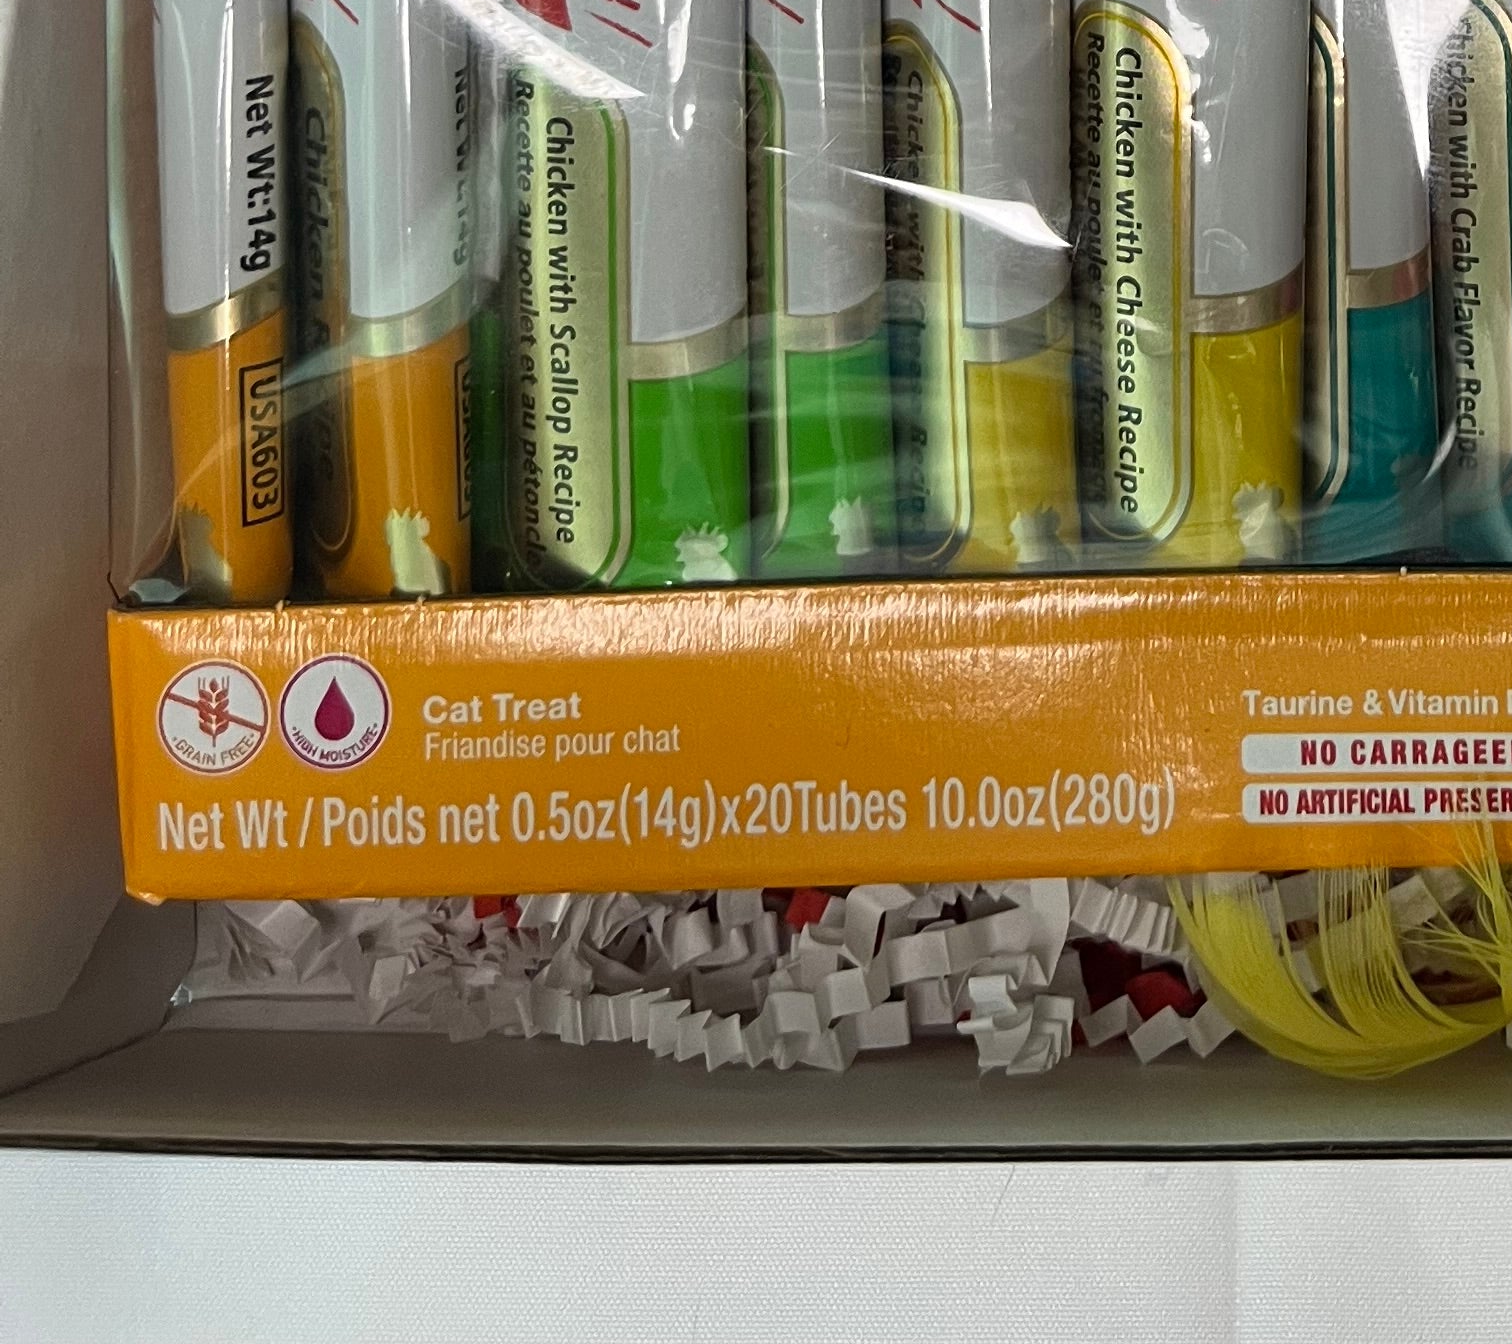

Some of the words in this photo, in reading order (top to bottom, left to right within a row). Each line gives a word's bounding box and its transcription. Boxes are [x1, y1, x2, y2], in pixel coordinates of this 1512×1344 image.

[244, 74, 275, 139] Net
[1085, 31, 1105, 145] Recette
[1115, 46, 1144, 179] Chicken
[512, 79, 534, 192] Recette
[1448, 136, 1478, 196] with
[240, 144, 278, 271] Wt:14g
[303, 107, 331, 302] Chicken
[546, 116, 573, 236] Chicken
[519, 200, 532, 233] au
[1116, 187, 1144, 263] with
[1450, 209, 1479, 272] Crab
[518, 247, 539, 339] poulet
[548, 244, 574, 314] with
[521, 344, 535, 375] et
[1116, 276, 1144, 395] Cheese
[1451, 277, 1481, 370] Flavor
[522, 394, 535, 429] au
[549, 326, 579, 434] Scallop
[248, 374, 279, 509] USA603
[1118, 406, 1144, 514] Recipe
[1455, 377, 1485, 472] Recipe
[554, 444, 579, 545] Recipe
[422, 696, 482, 724] Cat
[492, 692, 581, 721] Treat
[1242, 690, 1353, 716] Taurine
[1365, 692, 1383, 715] &
[1389, 688, 1499, 716] Vitamin
[175, 738, 216, 766] GRAIN
[221, 735, 254, 766] FREE
[320, 727, 378, 762] MOISTURE
[424, 730, 548, 761] Friandise
[554, 731, 616, 762] pour
[622, 723, 681, 753] chat
[1300, 739, 1341, 767] NO
[158, 800, 222, 851] Net
[236, 798, 289, 850] Wt
[299, 795, 314, 850] /
[323, 792, 427, 846] Poids
[439, 791, 500, 843] net
[924, 767, 1175, 836] 10.0oz(280g)
[1259, 789, 1290, 815] NO
[1296, 788, 1416, 815] ARTIFICIAL
